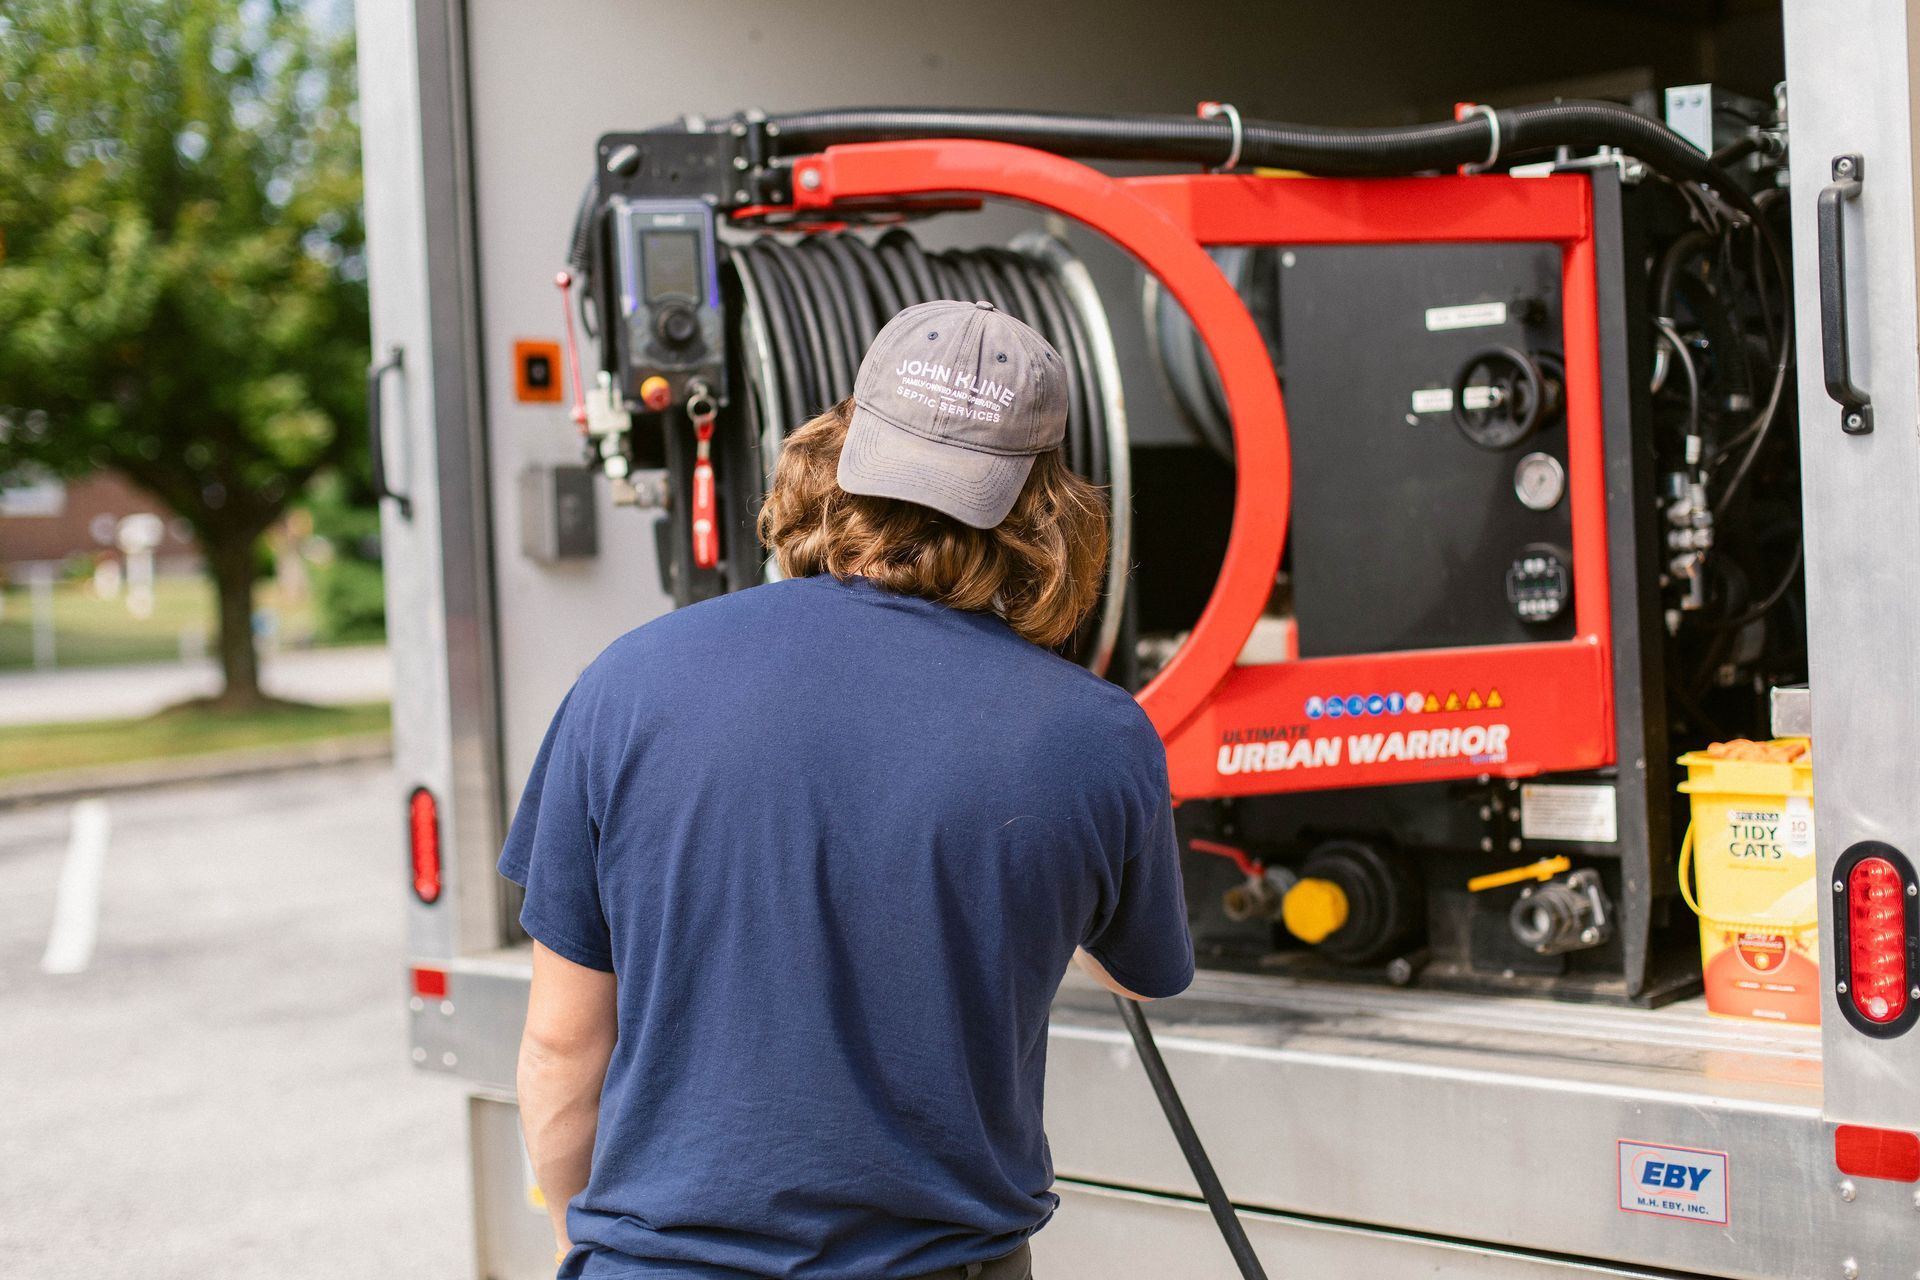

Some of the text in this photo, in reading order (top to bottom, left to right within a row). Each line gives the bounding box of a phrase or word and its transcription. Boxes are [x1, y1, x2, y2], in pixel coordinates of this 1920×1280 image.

[896, 360, 1015, 407] JOHN KLINE
[902, 377, 1001, 412] FAMILY OWNED AND OPERATED
[896, 385, 1001, 423] SEPTIC SERVICES
[1222, 726, 1309, 743] ULTIMATE
[1217, 724, 1510, 775] URBAN WARRIOR
[1731, 824, 1778, 841] TIDY
[1791, 820, 1807, 833] 10
[1729, 842, 1782, 859] CATS
[1641, 1160, 1712, 1192] EBY
[1637, 1197, 1709, 1215] M.H. EBY, INC.
